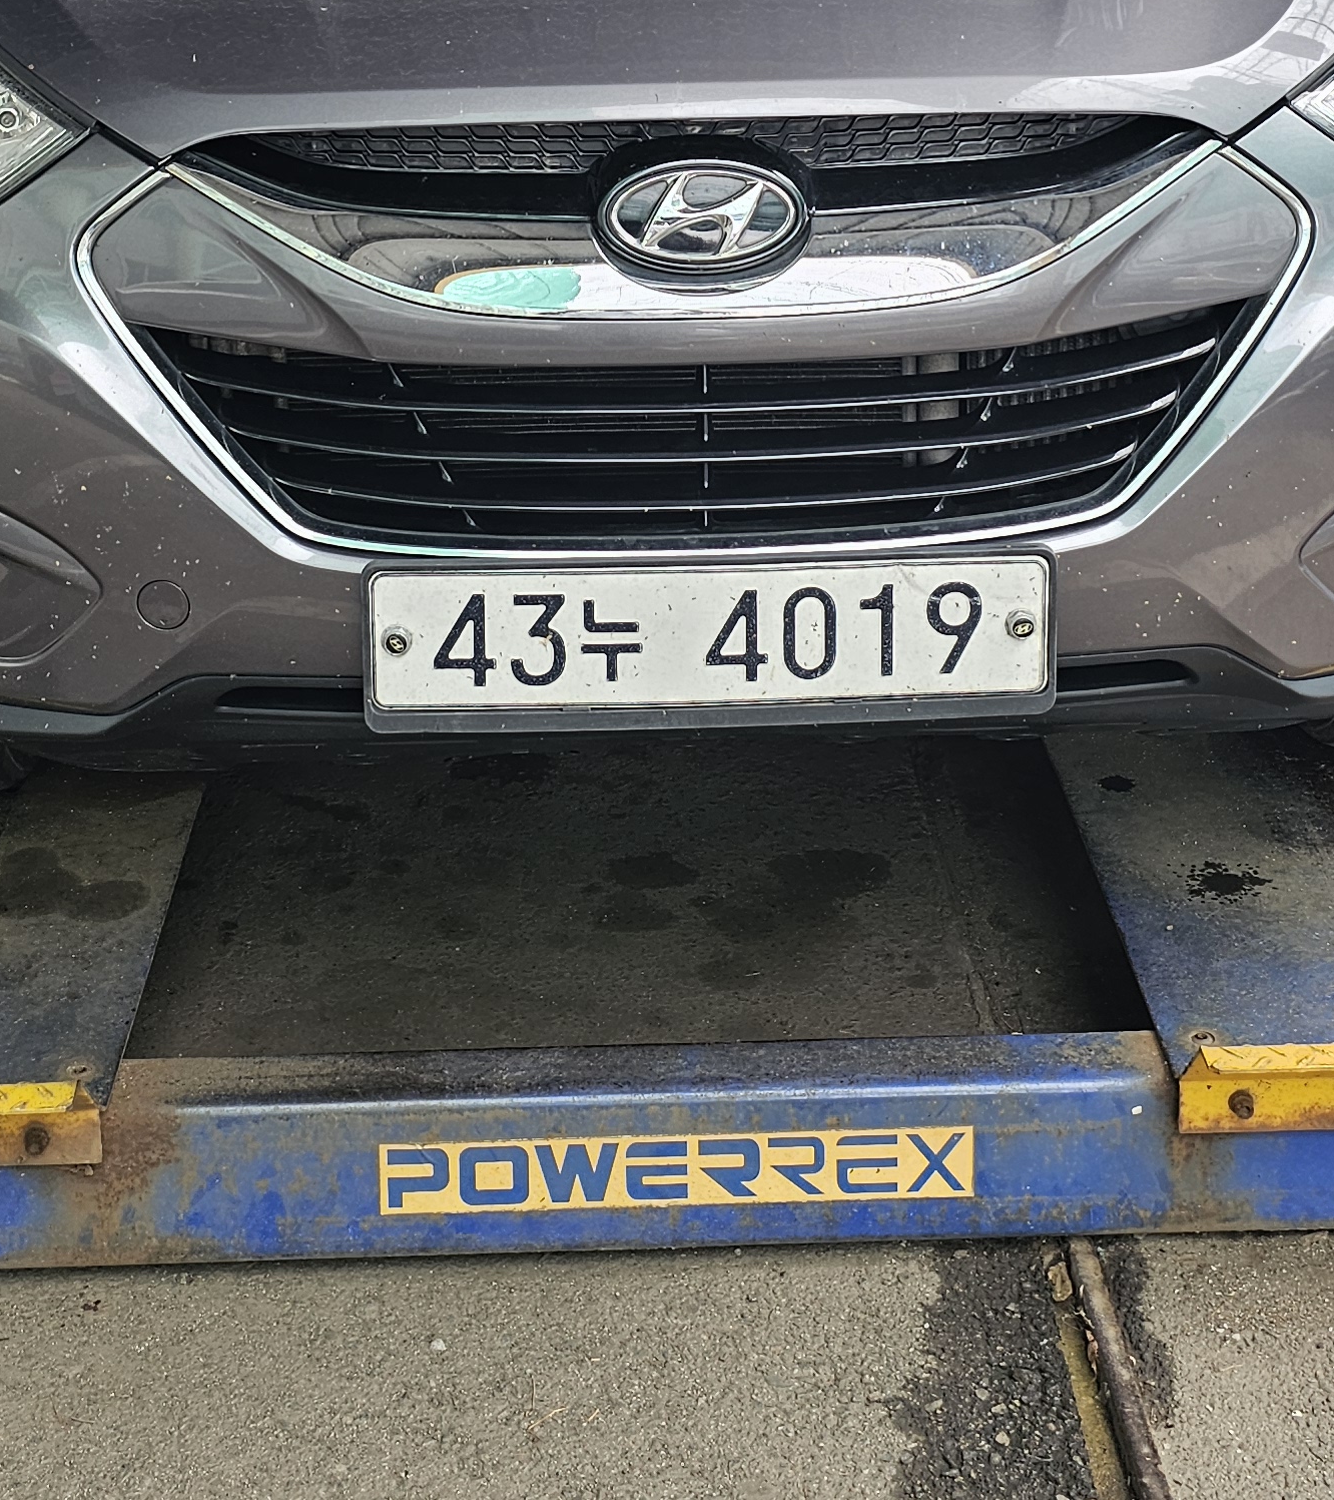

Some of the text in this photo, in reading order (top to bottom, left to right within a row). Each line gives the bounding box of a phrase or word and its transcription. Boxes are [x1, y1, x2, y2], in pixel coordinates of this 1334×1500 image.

[432, 580, 984, 688] 43누 4019
[386, 1132, 967, 1209] POWERREX
